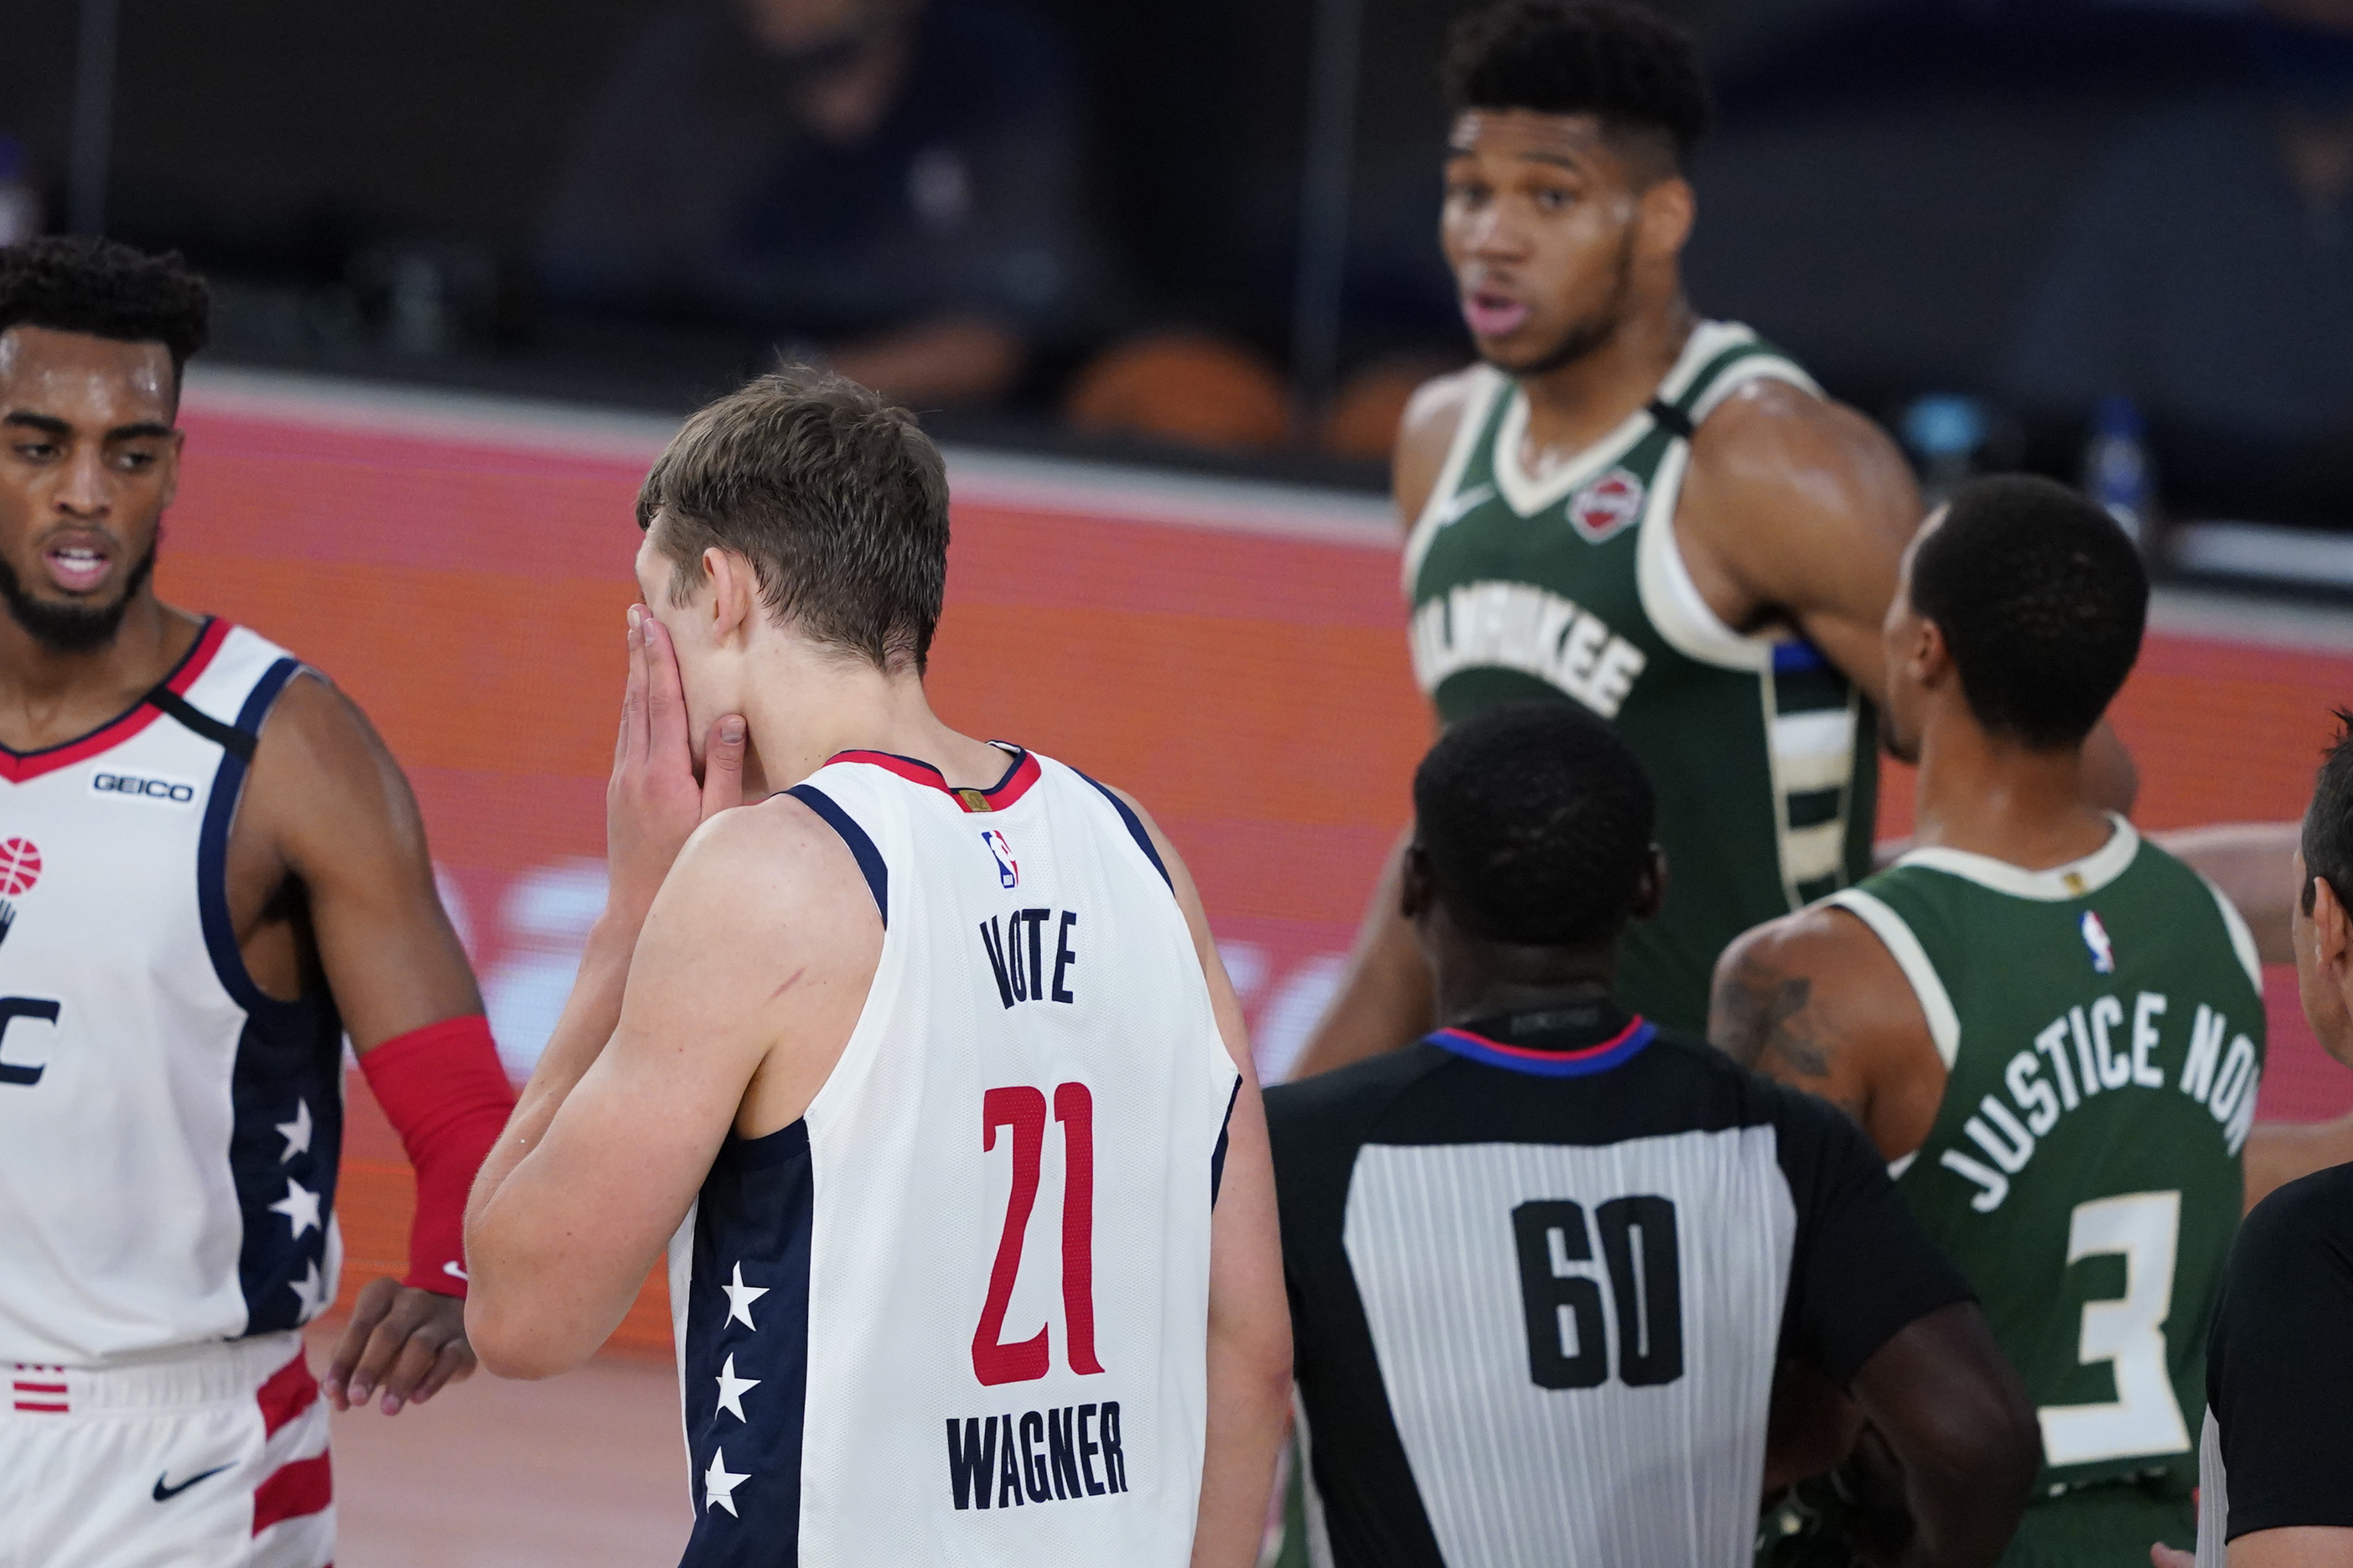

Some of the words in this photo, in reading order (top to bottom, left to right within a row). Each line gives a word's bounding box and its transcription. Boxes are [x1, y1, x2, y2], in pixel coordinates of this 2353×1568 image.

[1412, 580, 1647, 719] ILWAUKEE
[94, 773, 193, 802] GEICO
[979, 908, 1077, 1010] VOTE
[1939, 990, 2168, 1214] JUSTICE
[972, 1081, 1105, 1387] 21
[1511, 1192, 1684, 1391] 60
[2038, 1190, 2192, 1467] 3
[946, 1400, 1128, 1510] WAGNER
